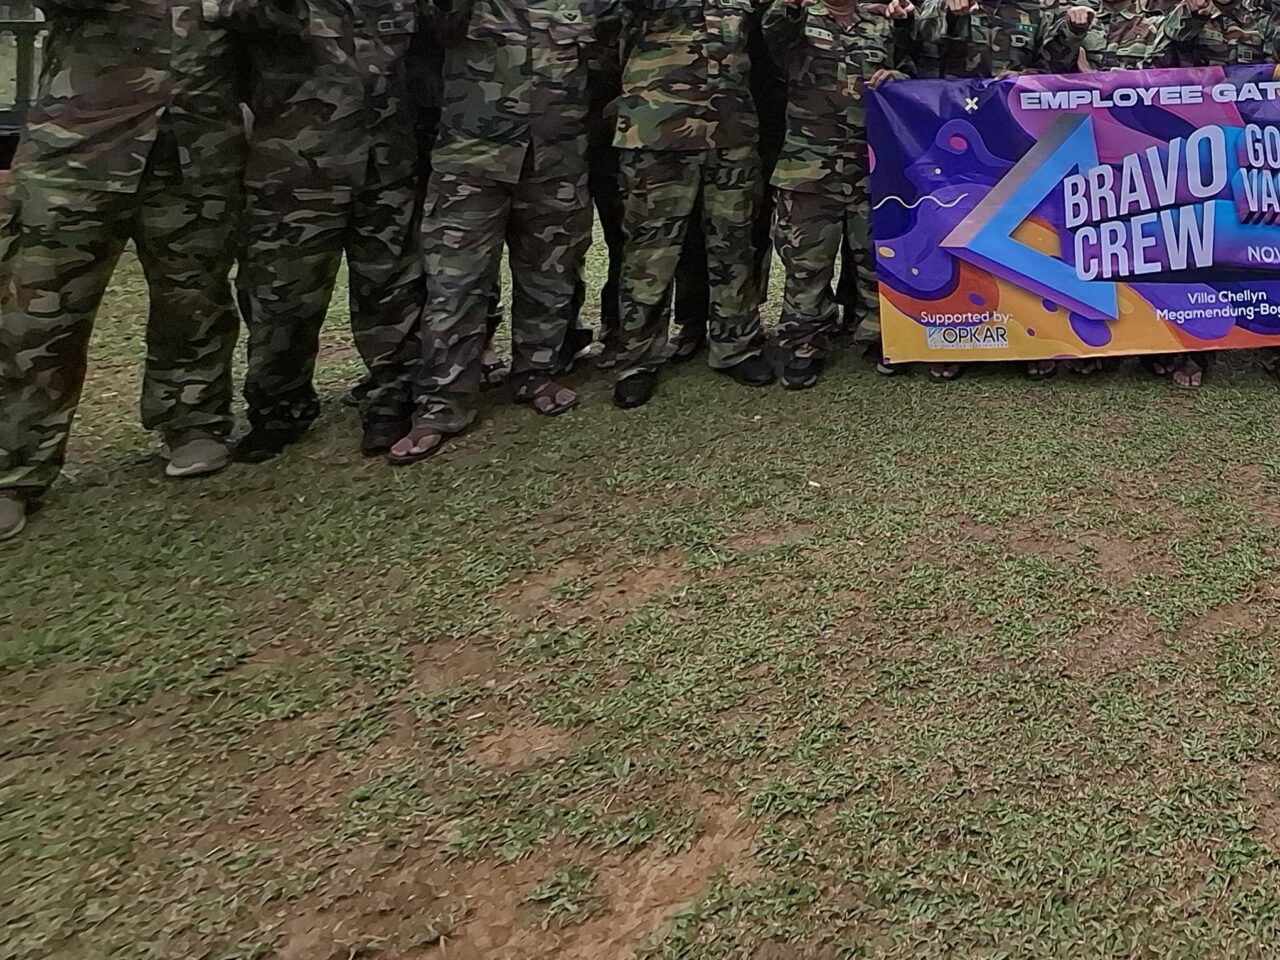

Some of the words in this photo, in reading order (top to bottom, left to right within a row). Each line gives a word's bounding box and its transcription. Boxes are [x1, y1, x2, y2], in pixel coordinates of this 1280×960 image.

[1020, 85, 1202, 110] EMPLOYEE
[1063, 124, 1228, 229] BRAVO
[1074, 200, 1216, 282] CREW
[1187, 291, 1216, 304] Villa
[1219, 289, 1267, 303] Chellyn
[921, 311, 989, 325] Supported
[993, 310, 1014, 324] by:
